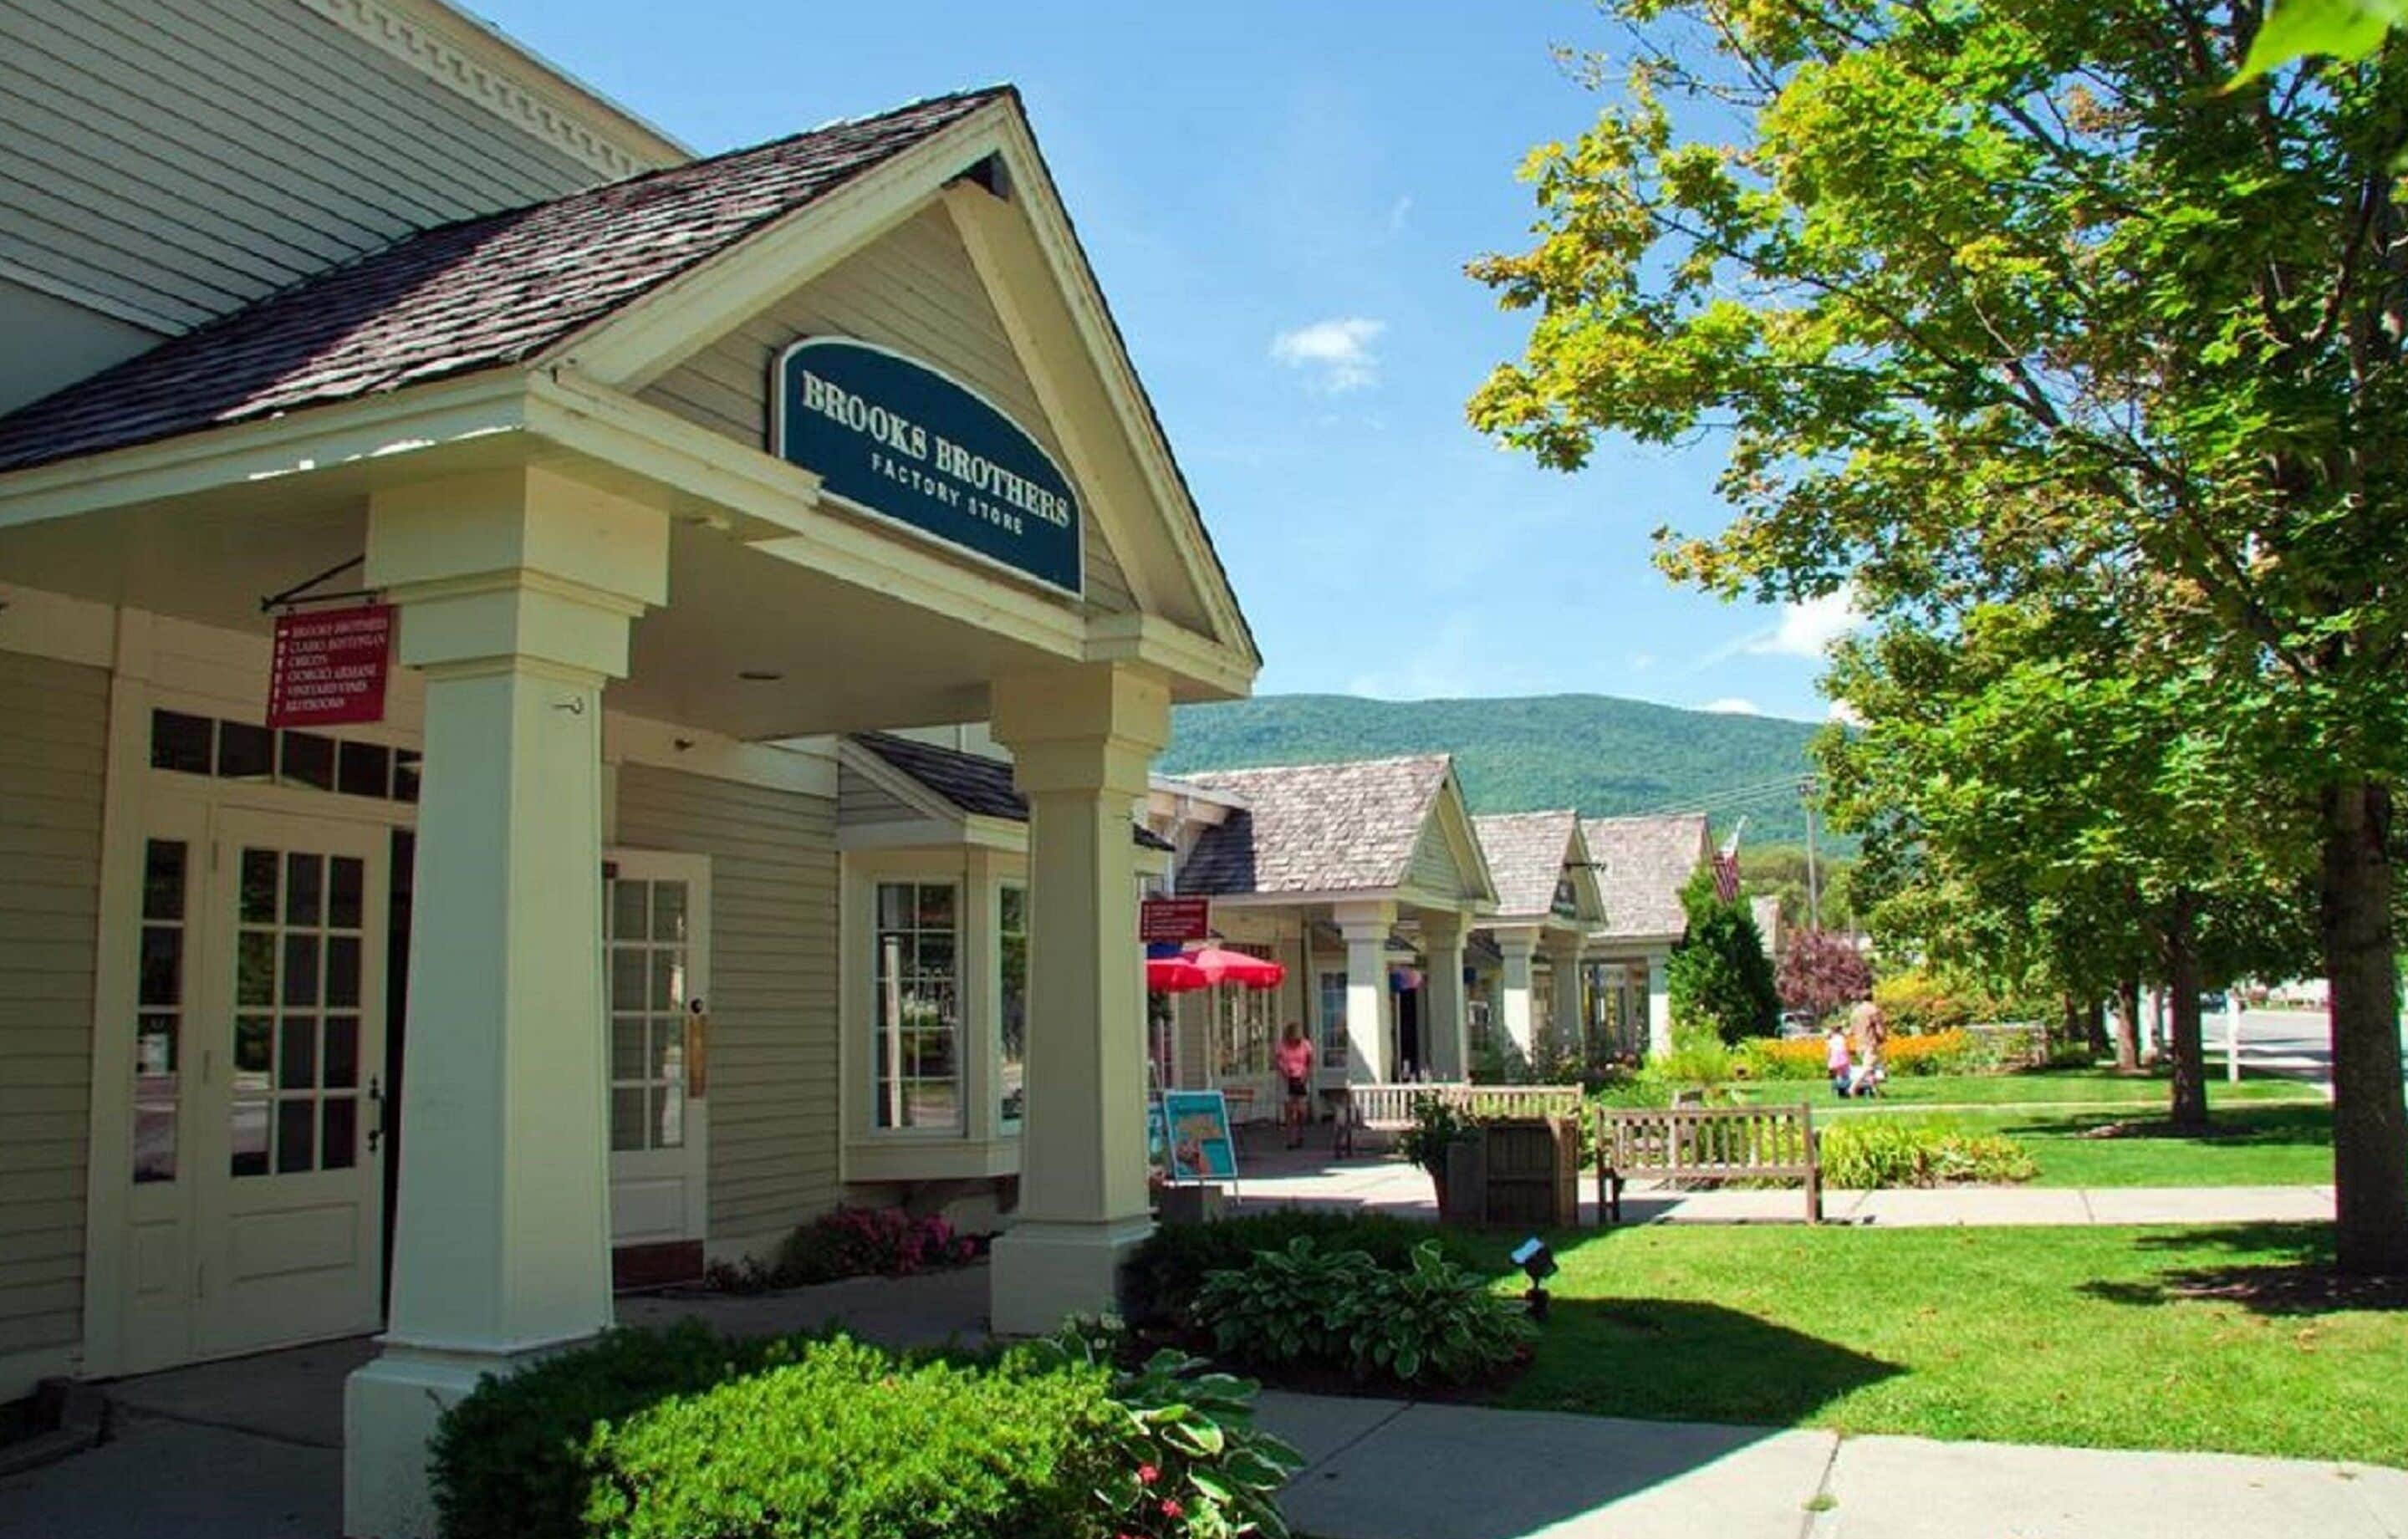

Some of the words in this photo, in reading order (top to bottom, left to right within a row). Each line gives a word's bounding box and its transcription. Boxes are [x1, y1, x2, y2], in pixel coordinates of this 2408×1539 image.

[802, 369, 928, 461] BROOKS
[934, 435, 1071, 529] BROTHERS
[871, 451, 961, 508] FACTORY
[967, 496, 1024, 536] STORE
